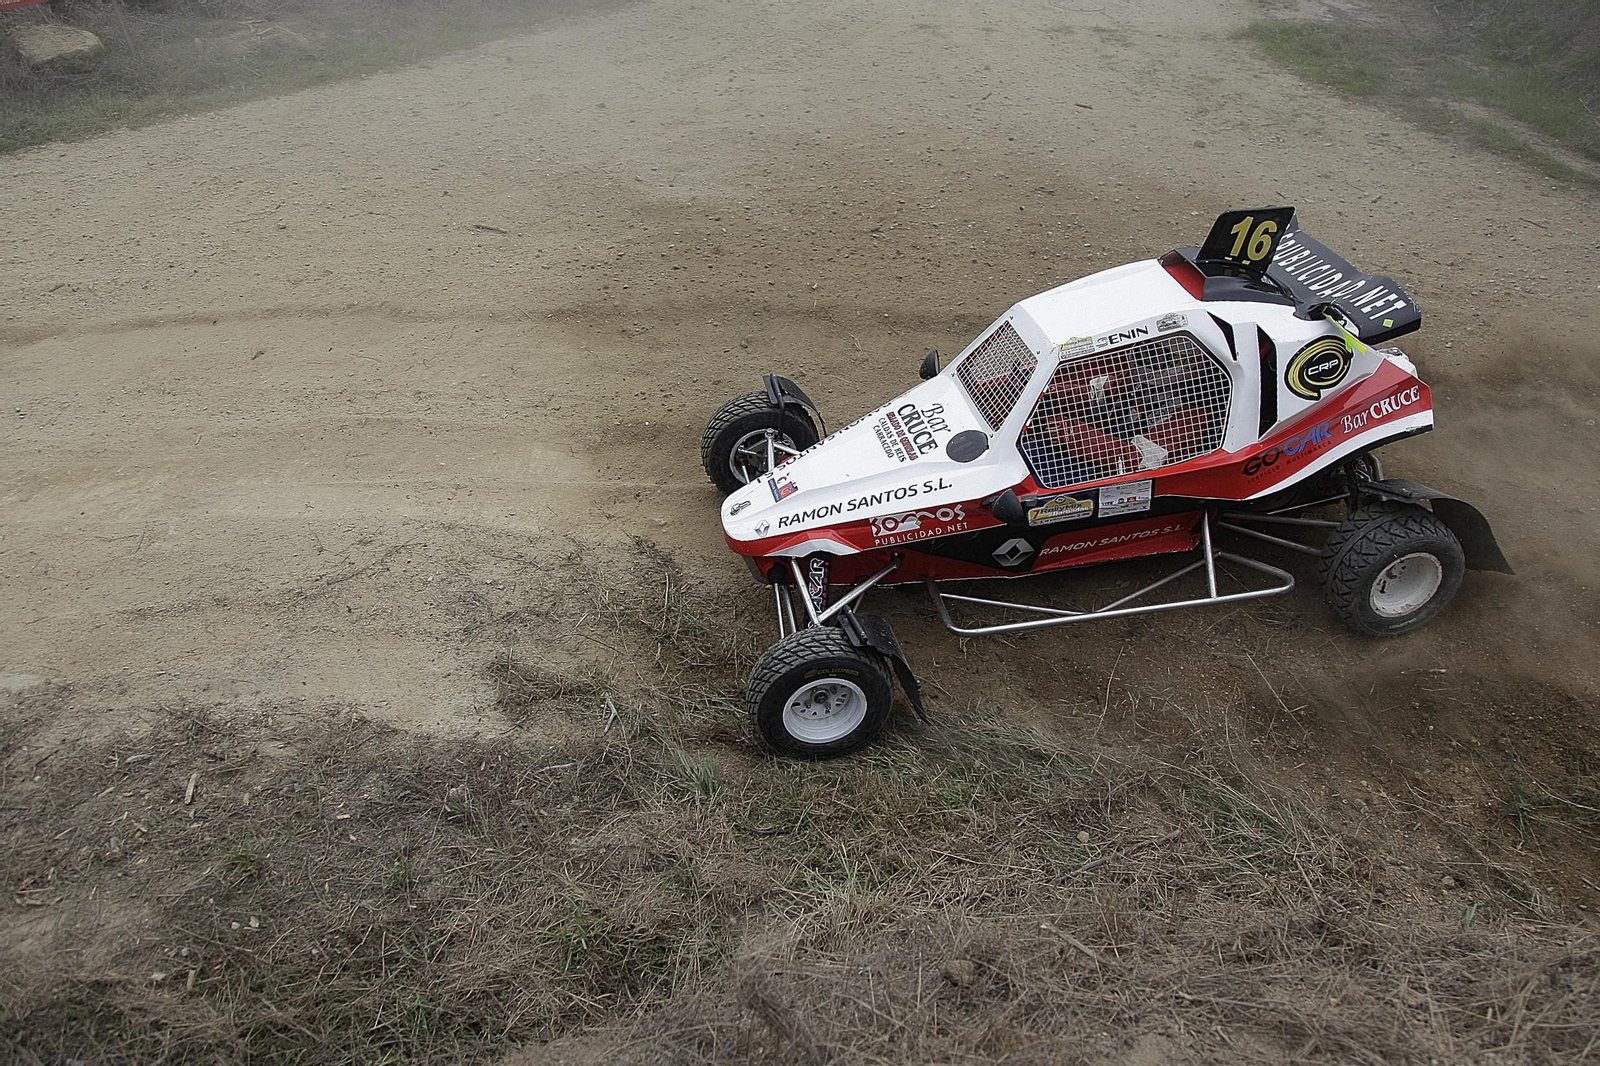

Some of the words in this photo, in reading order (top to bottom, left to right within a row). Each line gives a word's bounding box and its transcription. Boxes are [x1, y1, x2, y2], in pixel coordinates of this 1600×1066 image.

[1229, 215, 1277, 261] 16
[1308, 358, 1339, 376] CRP
[921, 403, 951, 433] Bar
[1340, 409, 1370, 434] Bar
[1369, 385, 1420, 420] CRUCE
[878, 417, 895, 439] CALDAS
[890, 438, 899, 448] DE
[898, 404, 938, 455] CRUCE
[1284, 421, 1332, 456] CAR
[894, 447, 907, 463] REIS
[1247, 465, 1280, 485] SERVICIO
[1286, 441, 1332, 465] MULTIMARCA
[778, 502, 843, 528] RAMON
[846, 485, 918, 512] SANTOS
[923, 477, 953, 495] S.L.
[875, 522, 968, 547] PUBLICIDAD.NET
[1038, 540, 1097, 557] RAMON
[1098, 529, 1160, 546] SANTOS
[1161, 523, 1185, 535] S.L.
